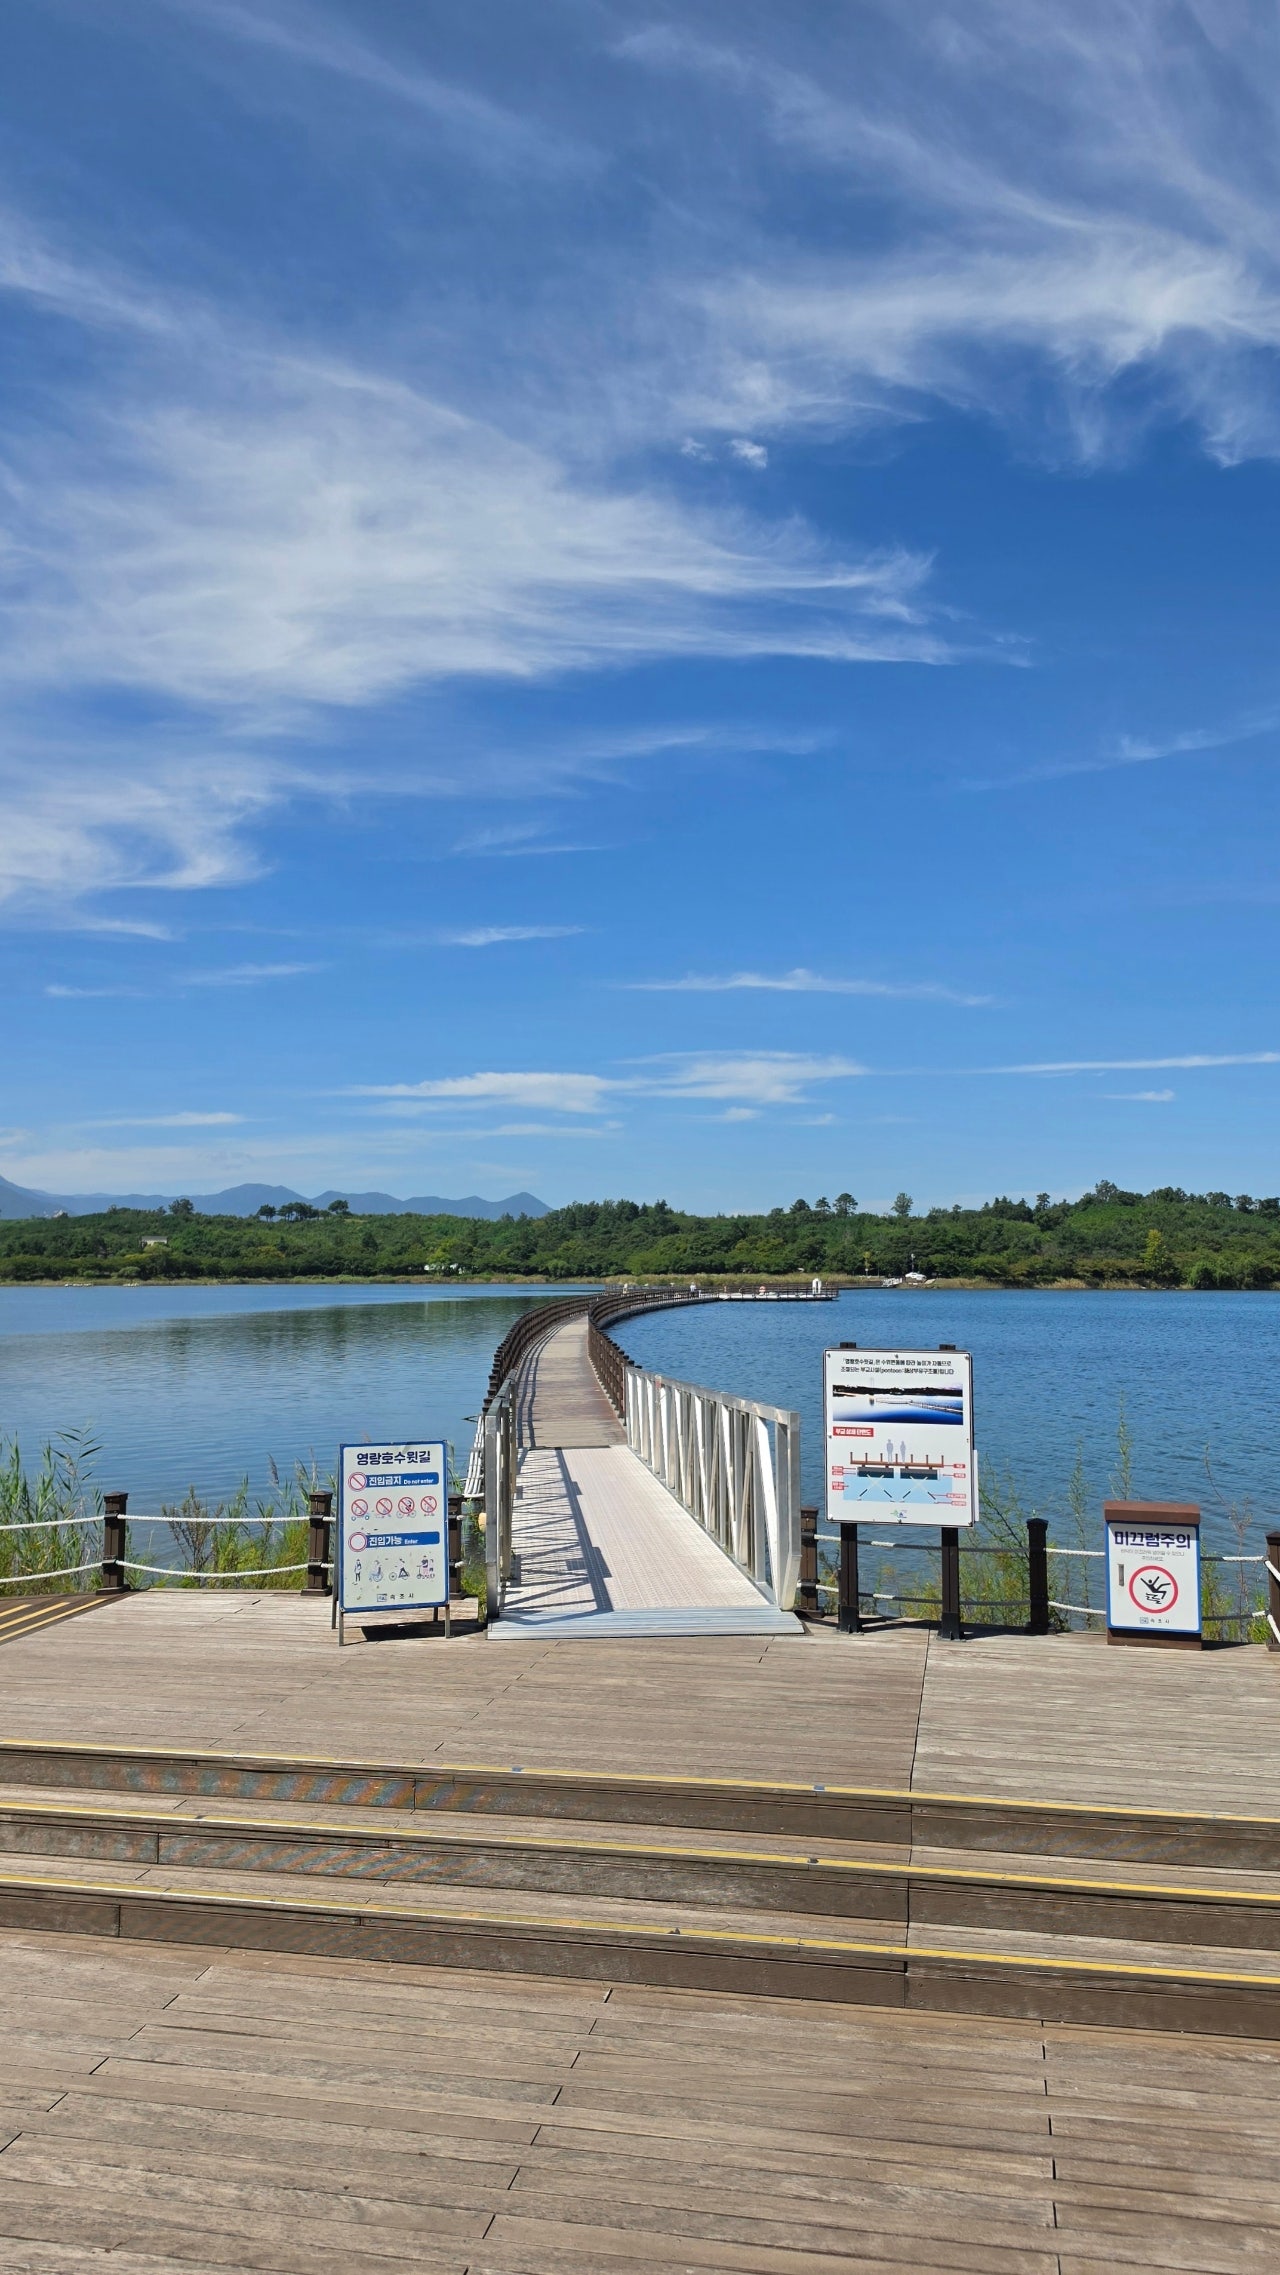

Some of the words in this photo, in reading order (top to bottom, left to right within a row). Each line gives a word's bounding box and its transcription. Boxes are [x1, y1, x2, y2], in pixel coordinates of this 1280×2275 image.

[356, 1451, 431, 1466] 영랑호수윗길
[369, 1476, 402, 1486] 진입금지
[369, 1536, 402, 1547] 진입가능
[1114, 1531, 1191, 1549] 미끄럼주의
